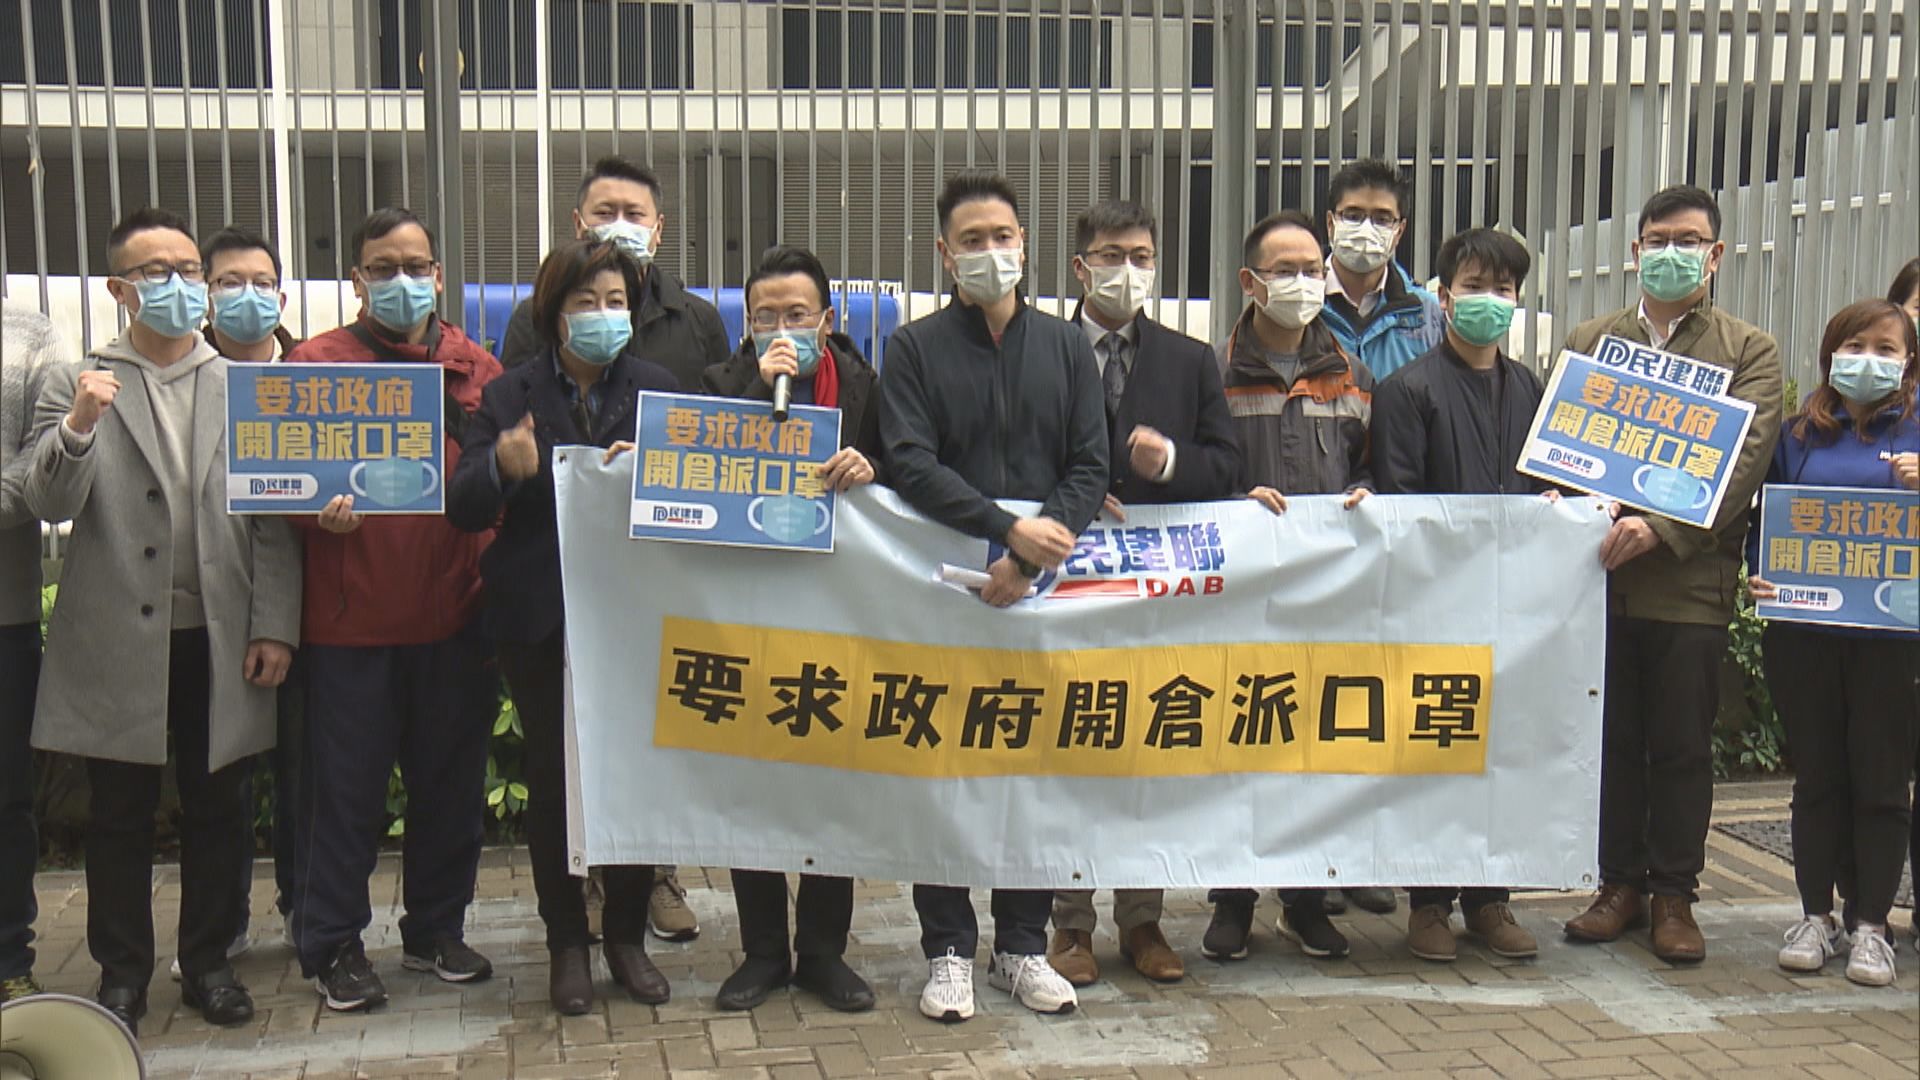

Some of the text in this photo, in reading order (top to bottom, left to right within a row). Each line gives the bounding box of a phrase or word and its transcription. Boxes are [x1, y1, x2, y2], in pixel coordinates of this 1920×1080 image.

[256, 376, 412, 416] 要求政府
[1580, 370, 1720, 441] 要求政府
[236, 421, 433, 461] 開倉派口罩
[665, 407, 814, 457] 要求政府
[1547, 399, 1724, 480] 開倉派口罩
[642, 448, 828, 499] 開倉派口罩
[1768, 537, 1919, 580] 開倉派口
[1144, 575, 1224, 598] DAB
[667, 646, 1484, 750] 要求政府開倉派口罩
